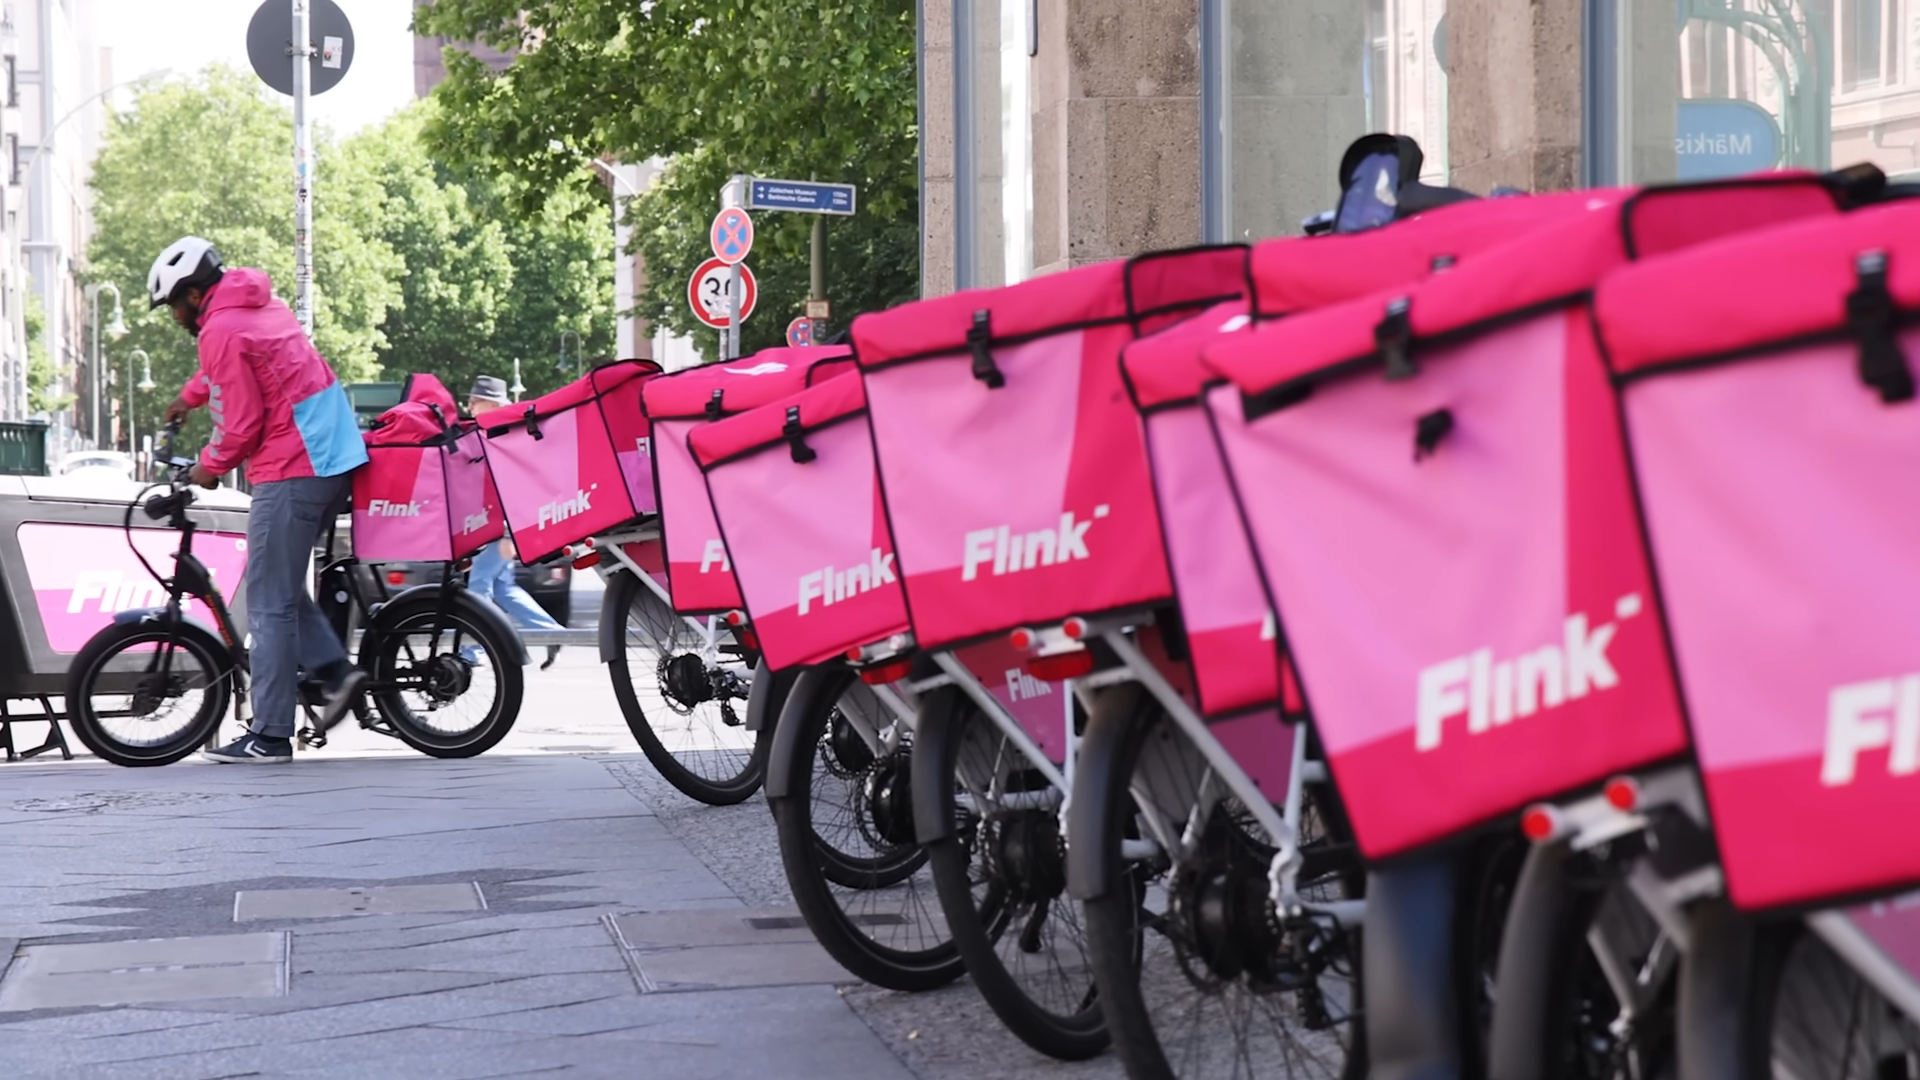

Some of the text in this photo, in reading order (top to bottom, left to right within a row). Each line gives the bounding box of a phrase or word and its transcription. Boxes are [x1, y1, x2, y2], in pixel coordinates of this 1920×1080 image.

[368, 499, 430, 517] Flink
[538, 483, 597, 531] Flink
[962, 504, 1110, 582] Flink
[797, 547, 897, 616] Flink
[1415, 593, 1641, 753] Flink
